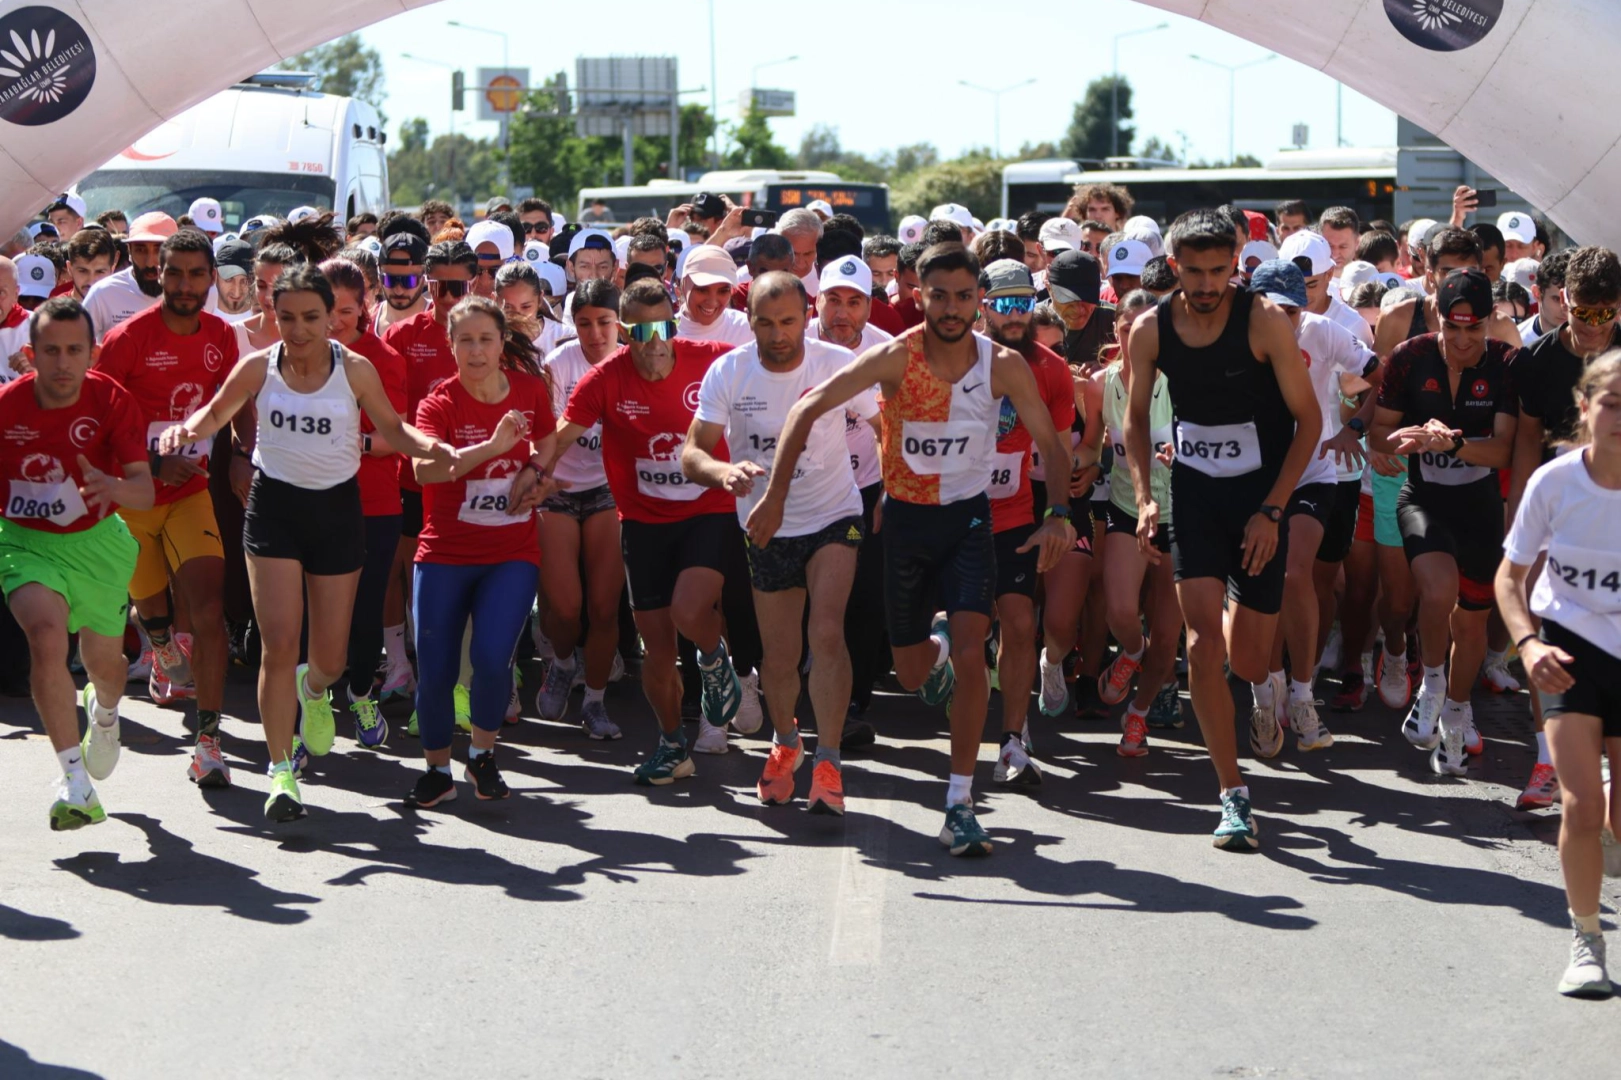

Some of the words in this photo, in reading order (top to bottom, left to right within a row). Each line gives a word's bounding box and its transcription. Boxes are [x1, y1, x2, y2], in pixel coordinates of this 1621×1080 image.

[1442, 0, 1488, 27] BELEDİYESİ
[0, 69, 42, 105] ARABAĞLAR
[41, 39, 85, 75] BELEDİYESİ
[270, 410, 332, 435] 0138
[905, 436, 970, 456] 0677
[1181, 440, 1242, 459] 0673
[1548, 555, 1621, 593] 0214
